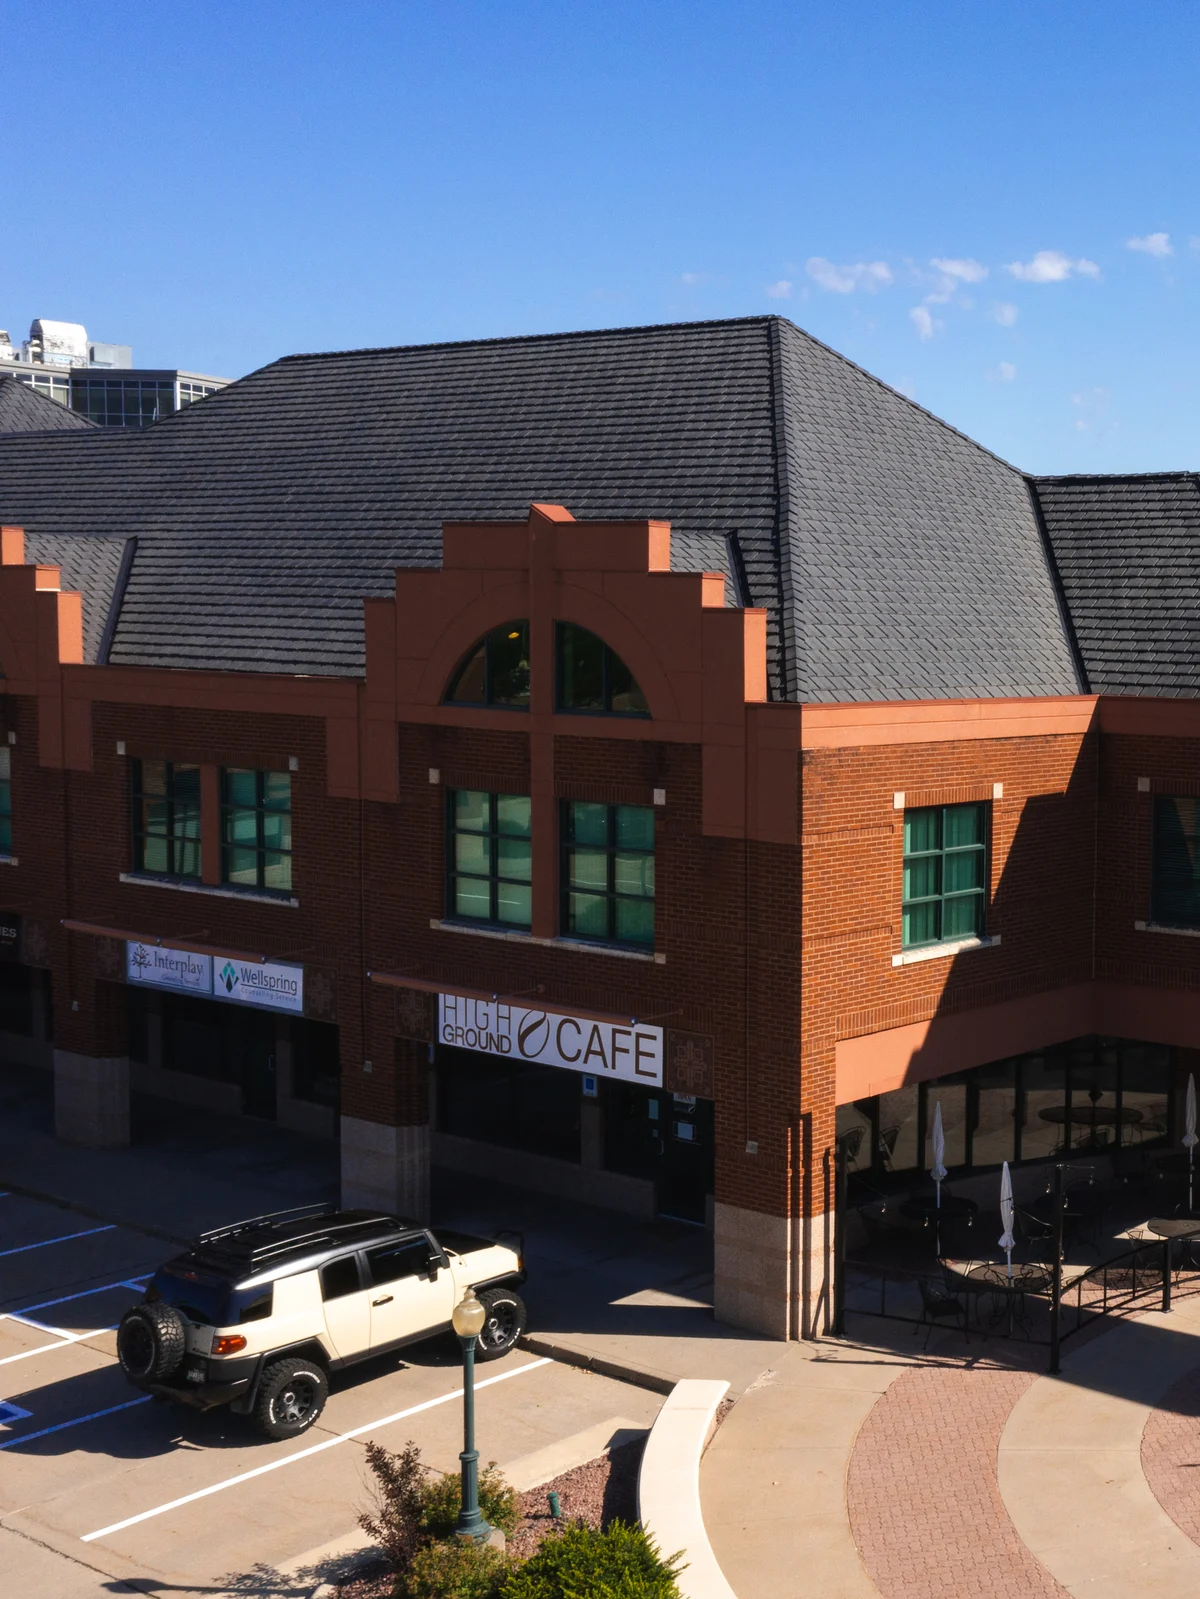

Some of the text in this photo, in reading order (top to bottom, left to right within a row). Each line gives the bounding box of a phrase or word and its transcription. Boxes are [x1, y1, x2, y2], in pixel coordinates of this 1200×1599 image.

[154, 950, 204, 982] Interplay
[240, 967, 297, 996] Wellspring
[443, 994, 511, 1035] HIGH
[442, 1023, 511, 1054] GROUND
[556, 1018, 658, 1079] CAFE
